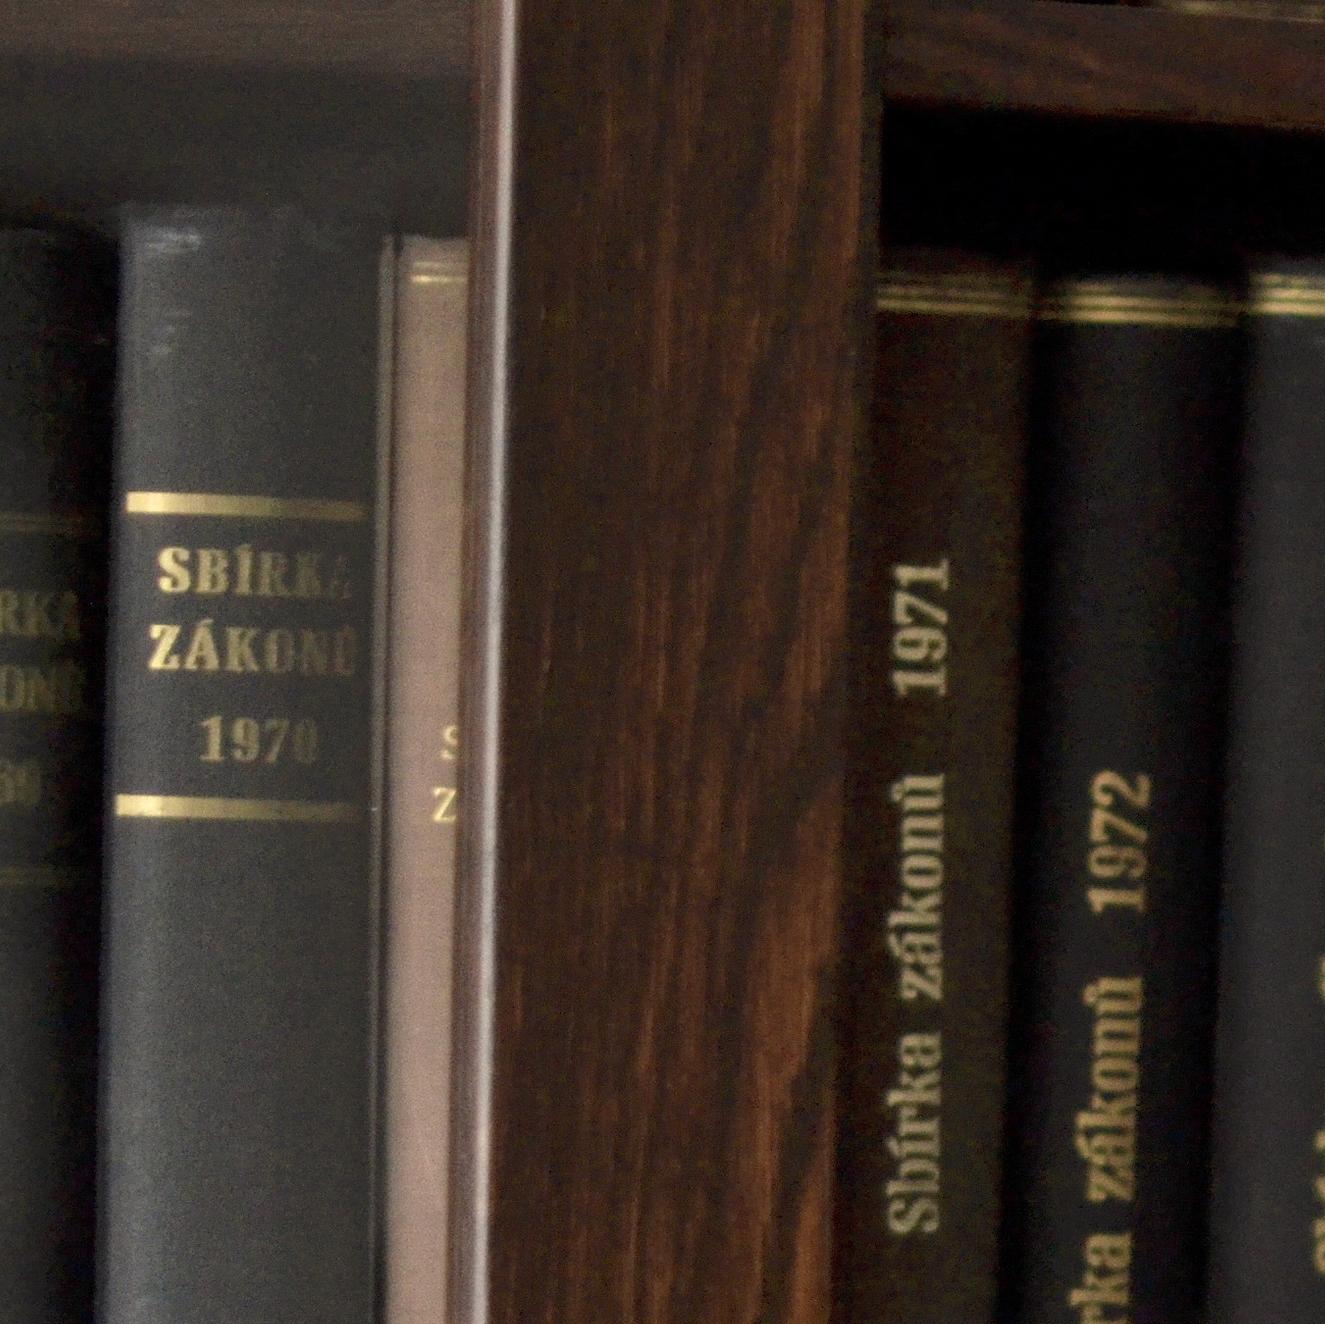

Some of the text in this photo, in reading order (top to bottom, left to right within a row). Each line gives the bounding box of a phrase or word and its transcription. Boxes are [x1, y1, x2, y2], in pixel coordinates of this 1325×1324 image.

[885, 560, 949, 1235] Sbírka zákonů 1971
[1087, 770, 1150, 913] 1972
[1074, 977, 1141, 1202] zákonů
